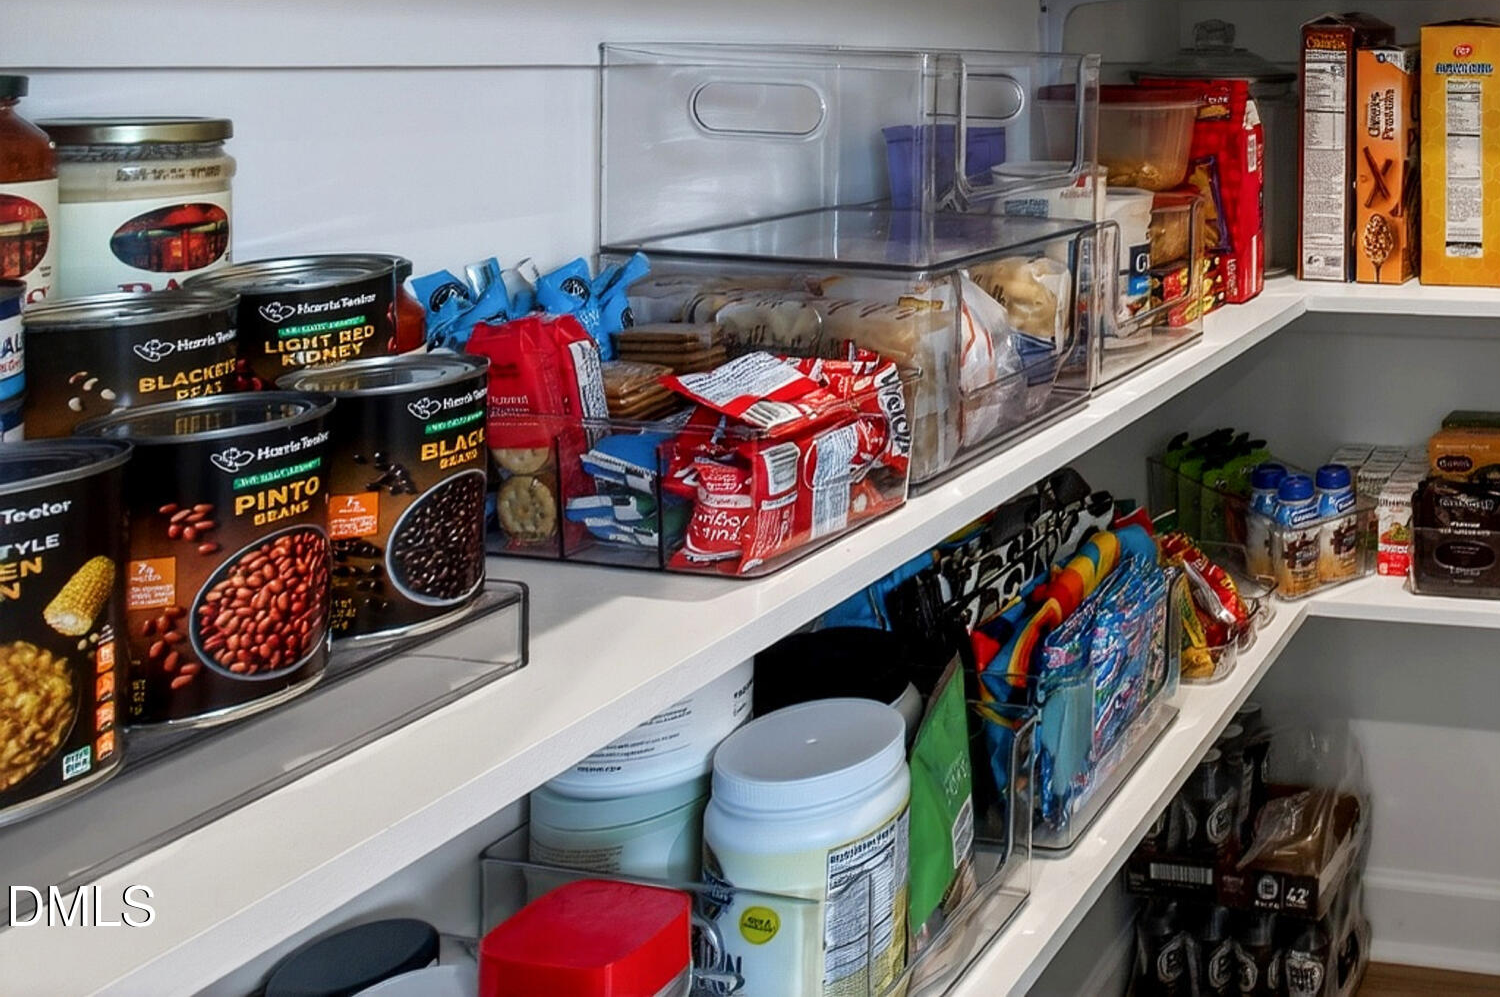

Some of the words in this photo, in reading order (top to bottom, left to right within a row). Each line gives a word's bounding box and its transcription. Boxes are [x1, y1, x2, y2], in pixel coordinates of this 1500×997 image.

[264, 333, 332, 354] LIGHT
[339, 325, 376, 344] RED
[281, 341, 365, 367] KIDNEY
[234, 475, 321, 517] PINTO
